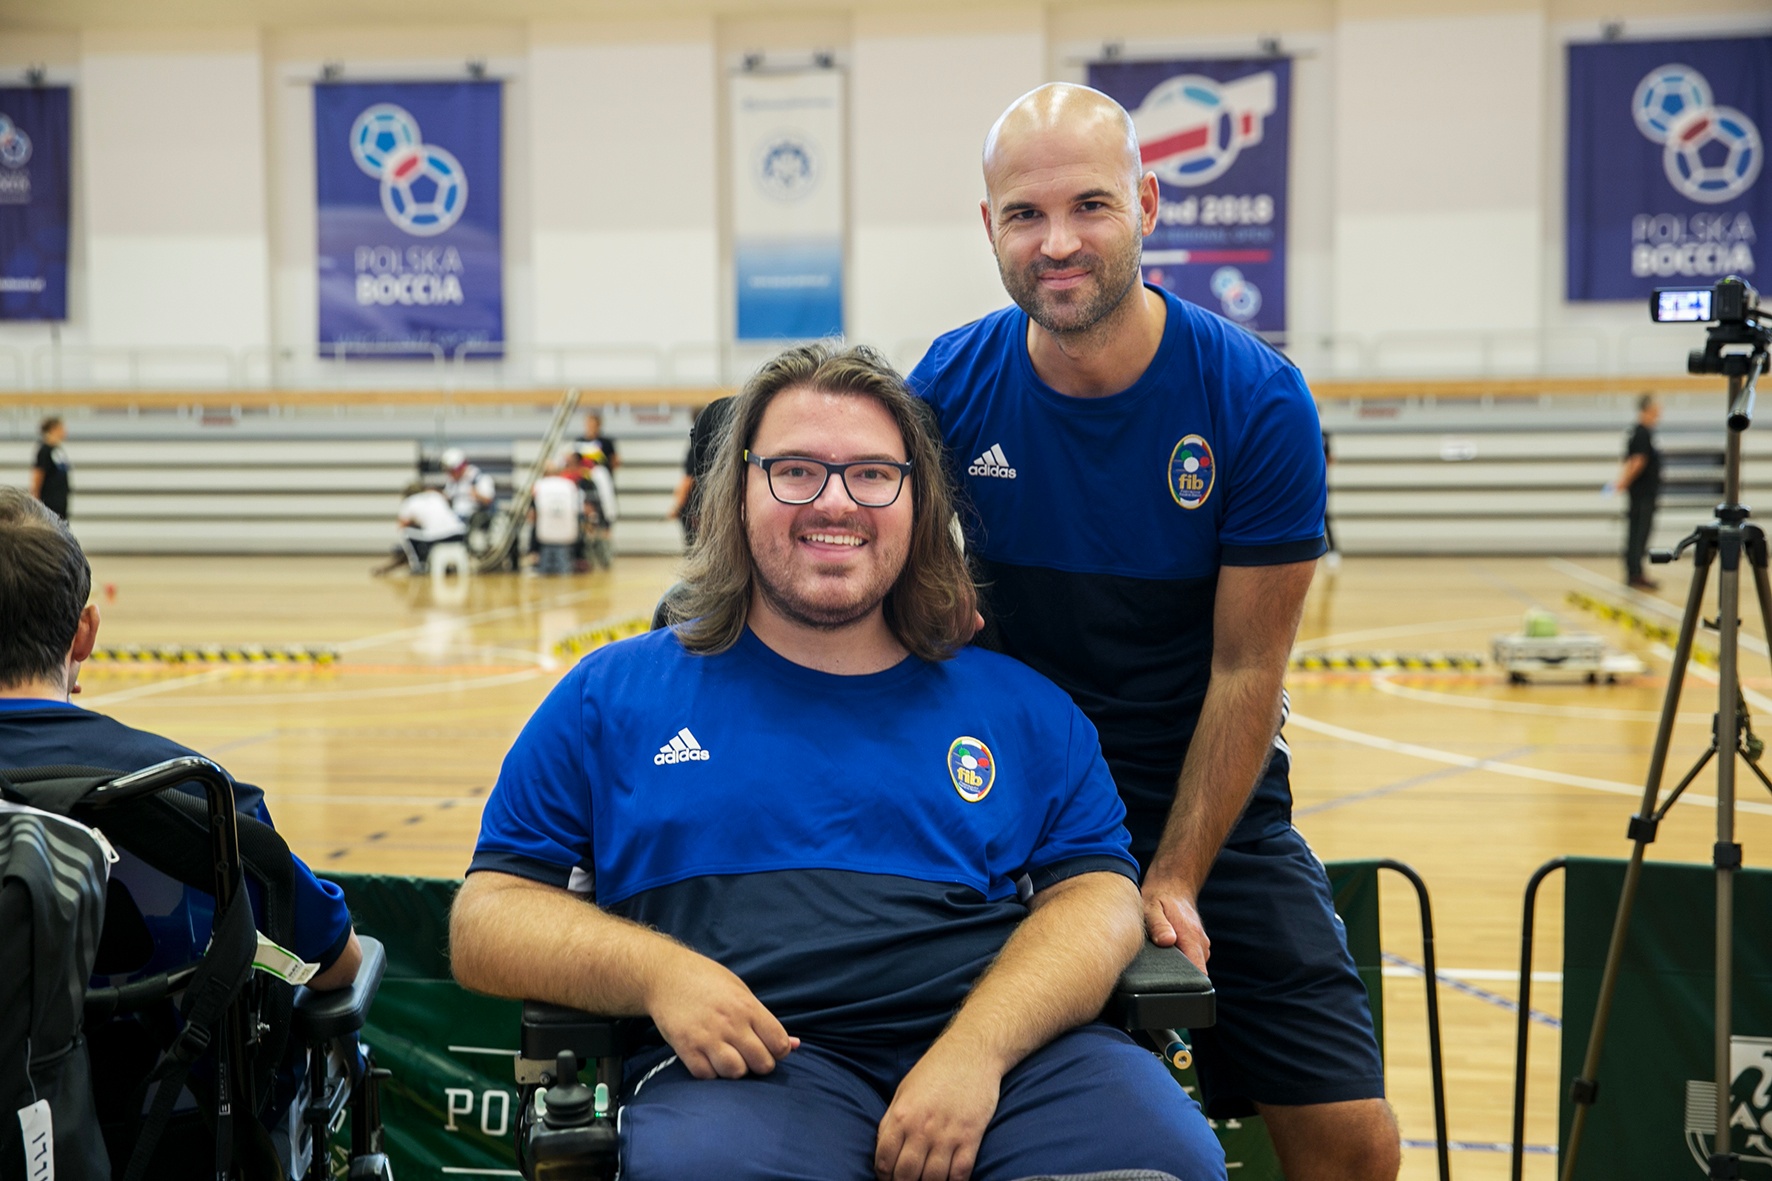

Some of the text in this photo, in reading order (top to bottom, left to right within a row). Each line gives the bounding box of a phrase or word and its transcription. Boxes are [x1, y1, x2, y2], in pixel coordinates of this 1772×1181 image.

[1159, 194, 1275, 225] ed 2018
[1631, 213, 1757, 244] POLSKA
[354, 246, 464, 275] POLSKA
[1631, 243, 1756, 277] BOCCIA
[356, 274, 465, 305] BOCCIA
[968, 464, 1017, 479] adidas
[1178, 473, 1204, 490] fib
[653, 749, 711, 766] adidas
[956, 766, 983, 787] fib
[444, 1087, 510, 1136] PO
